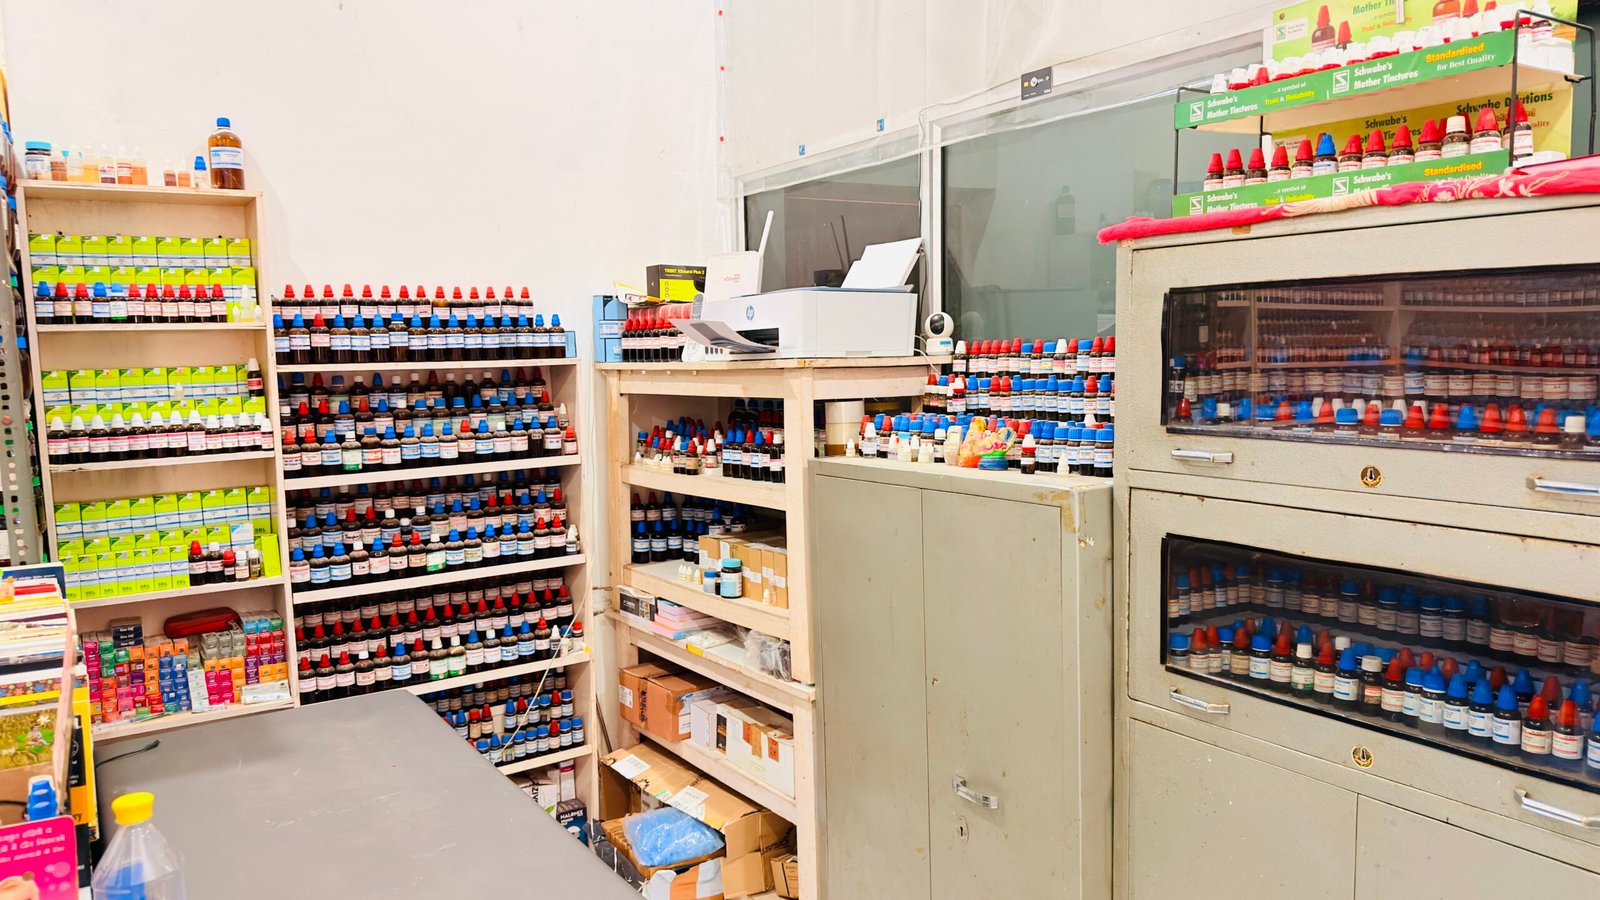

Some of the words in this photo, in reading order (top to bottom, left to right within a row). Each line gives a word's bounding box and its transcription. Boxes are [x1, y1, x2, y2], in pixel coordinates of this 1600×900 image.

[1353, 1, 1381, 15] Mother
[1426, 42, 1485, 63] Standardised
[1354, 62, 1393, 77] Schwabe's
[1437, 62, 1448, 72] for
[1450, 59, 1465, 69] Best
[1467, 53, 1496, 66] Quality
[1354, 77, 1380, 90] Mother
[1383, 70, 1418, 84] Tinctures
[1207, 95, 1238, 108] Schwabe's
[1286, 91, 1315, 101] Reliability
[1207, 108, 1228, 119] Mother
[1230, 104, 1258, 116] Tinctures
[1457, 99, 1501, 114] Schwabe
[1365, 116, 1407, 129] Schwabe's
[1424, 161, 1482, 177] Standardised
[1354, 172, 1392, 184] Schwabe's
[1207, 192, 1238, 203] Schwabe's
[1230, 202, 1258, 212] Tinctures
